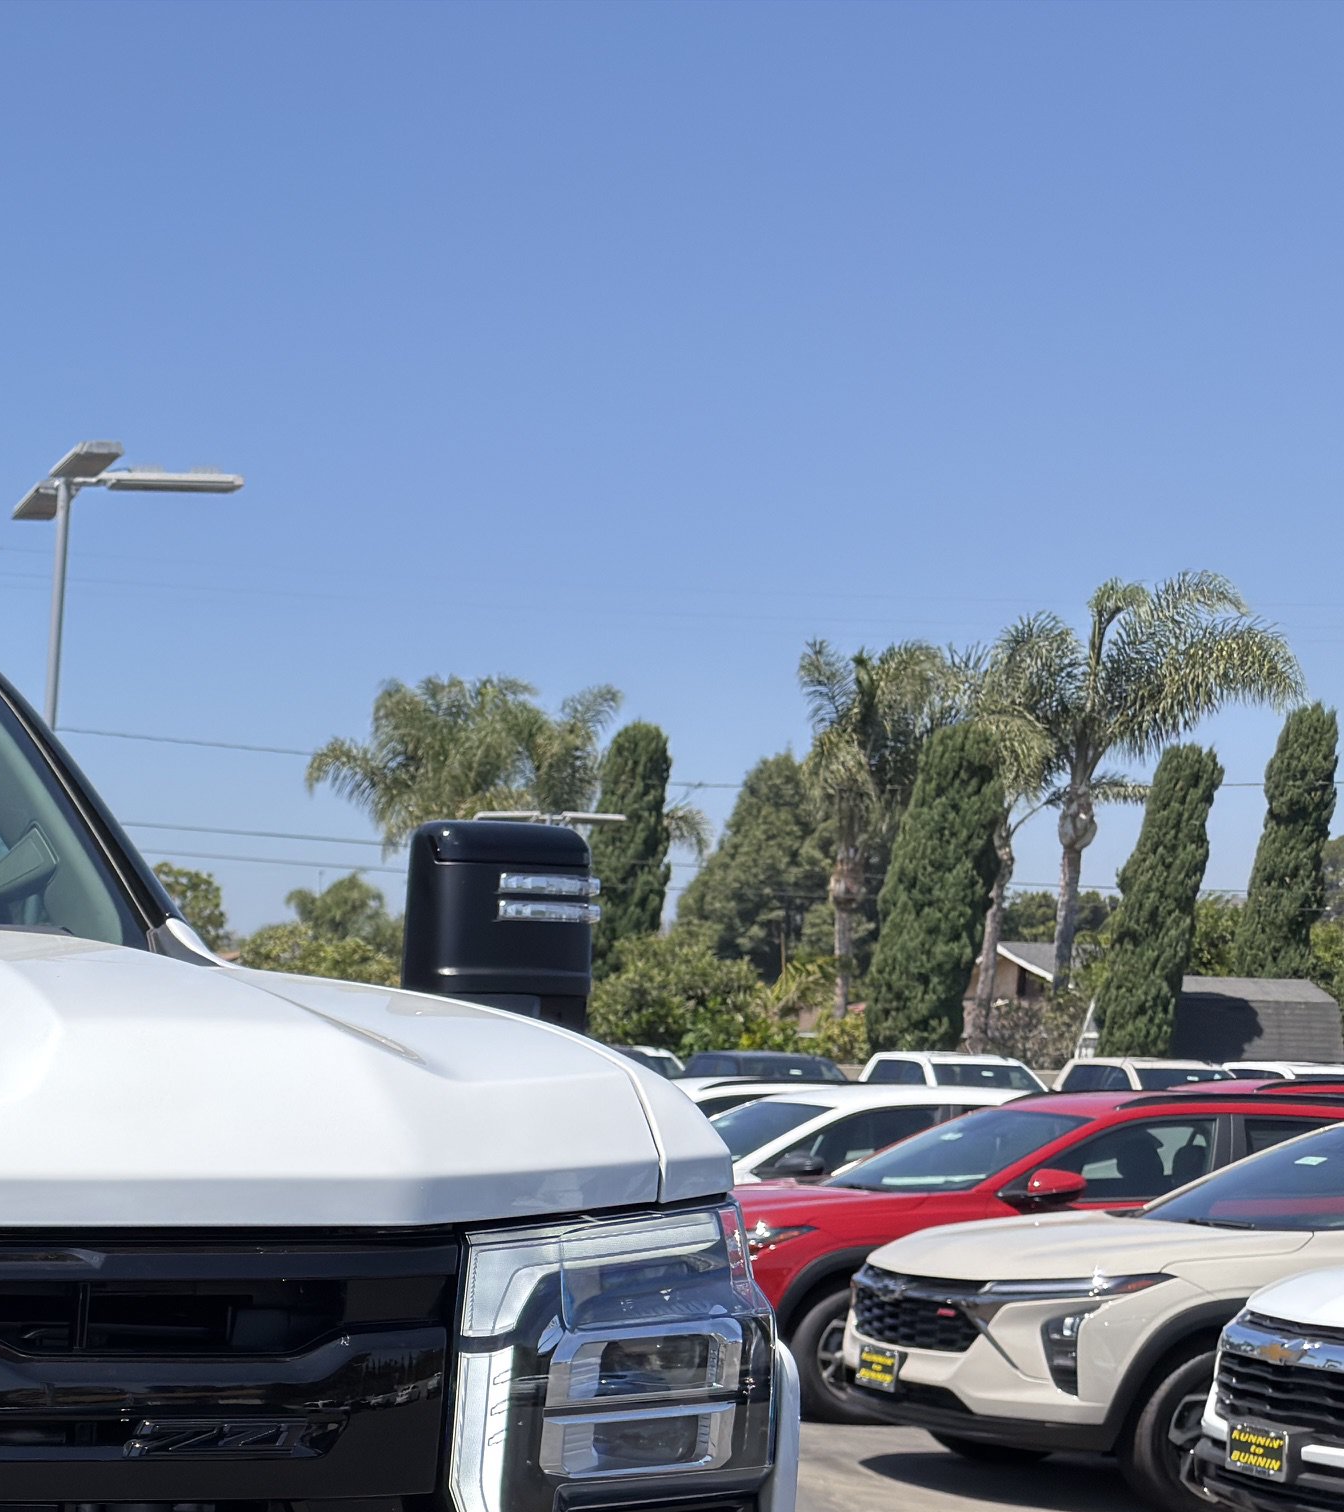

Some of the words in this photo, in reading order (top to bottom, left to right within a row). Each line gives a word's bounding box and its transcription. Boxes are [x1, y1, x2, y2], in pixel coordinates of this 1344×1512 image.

[1231, 1429, 1284, 1449] RUNNIN'
[1250, 1444, 1264, 1455] to
[1230, 1450, 1281, 1471] BUNNIN
